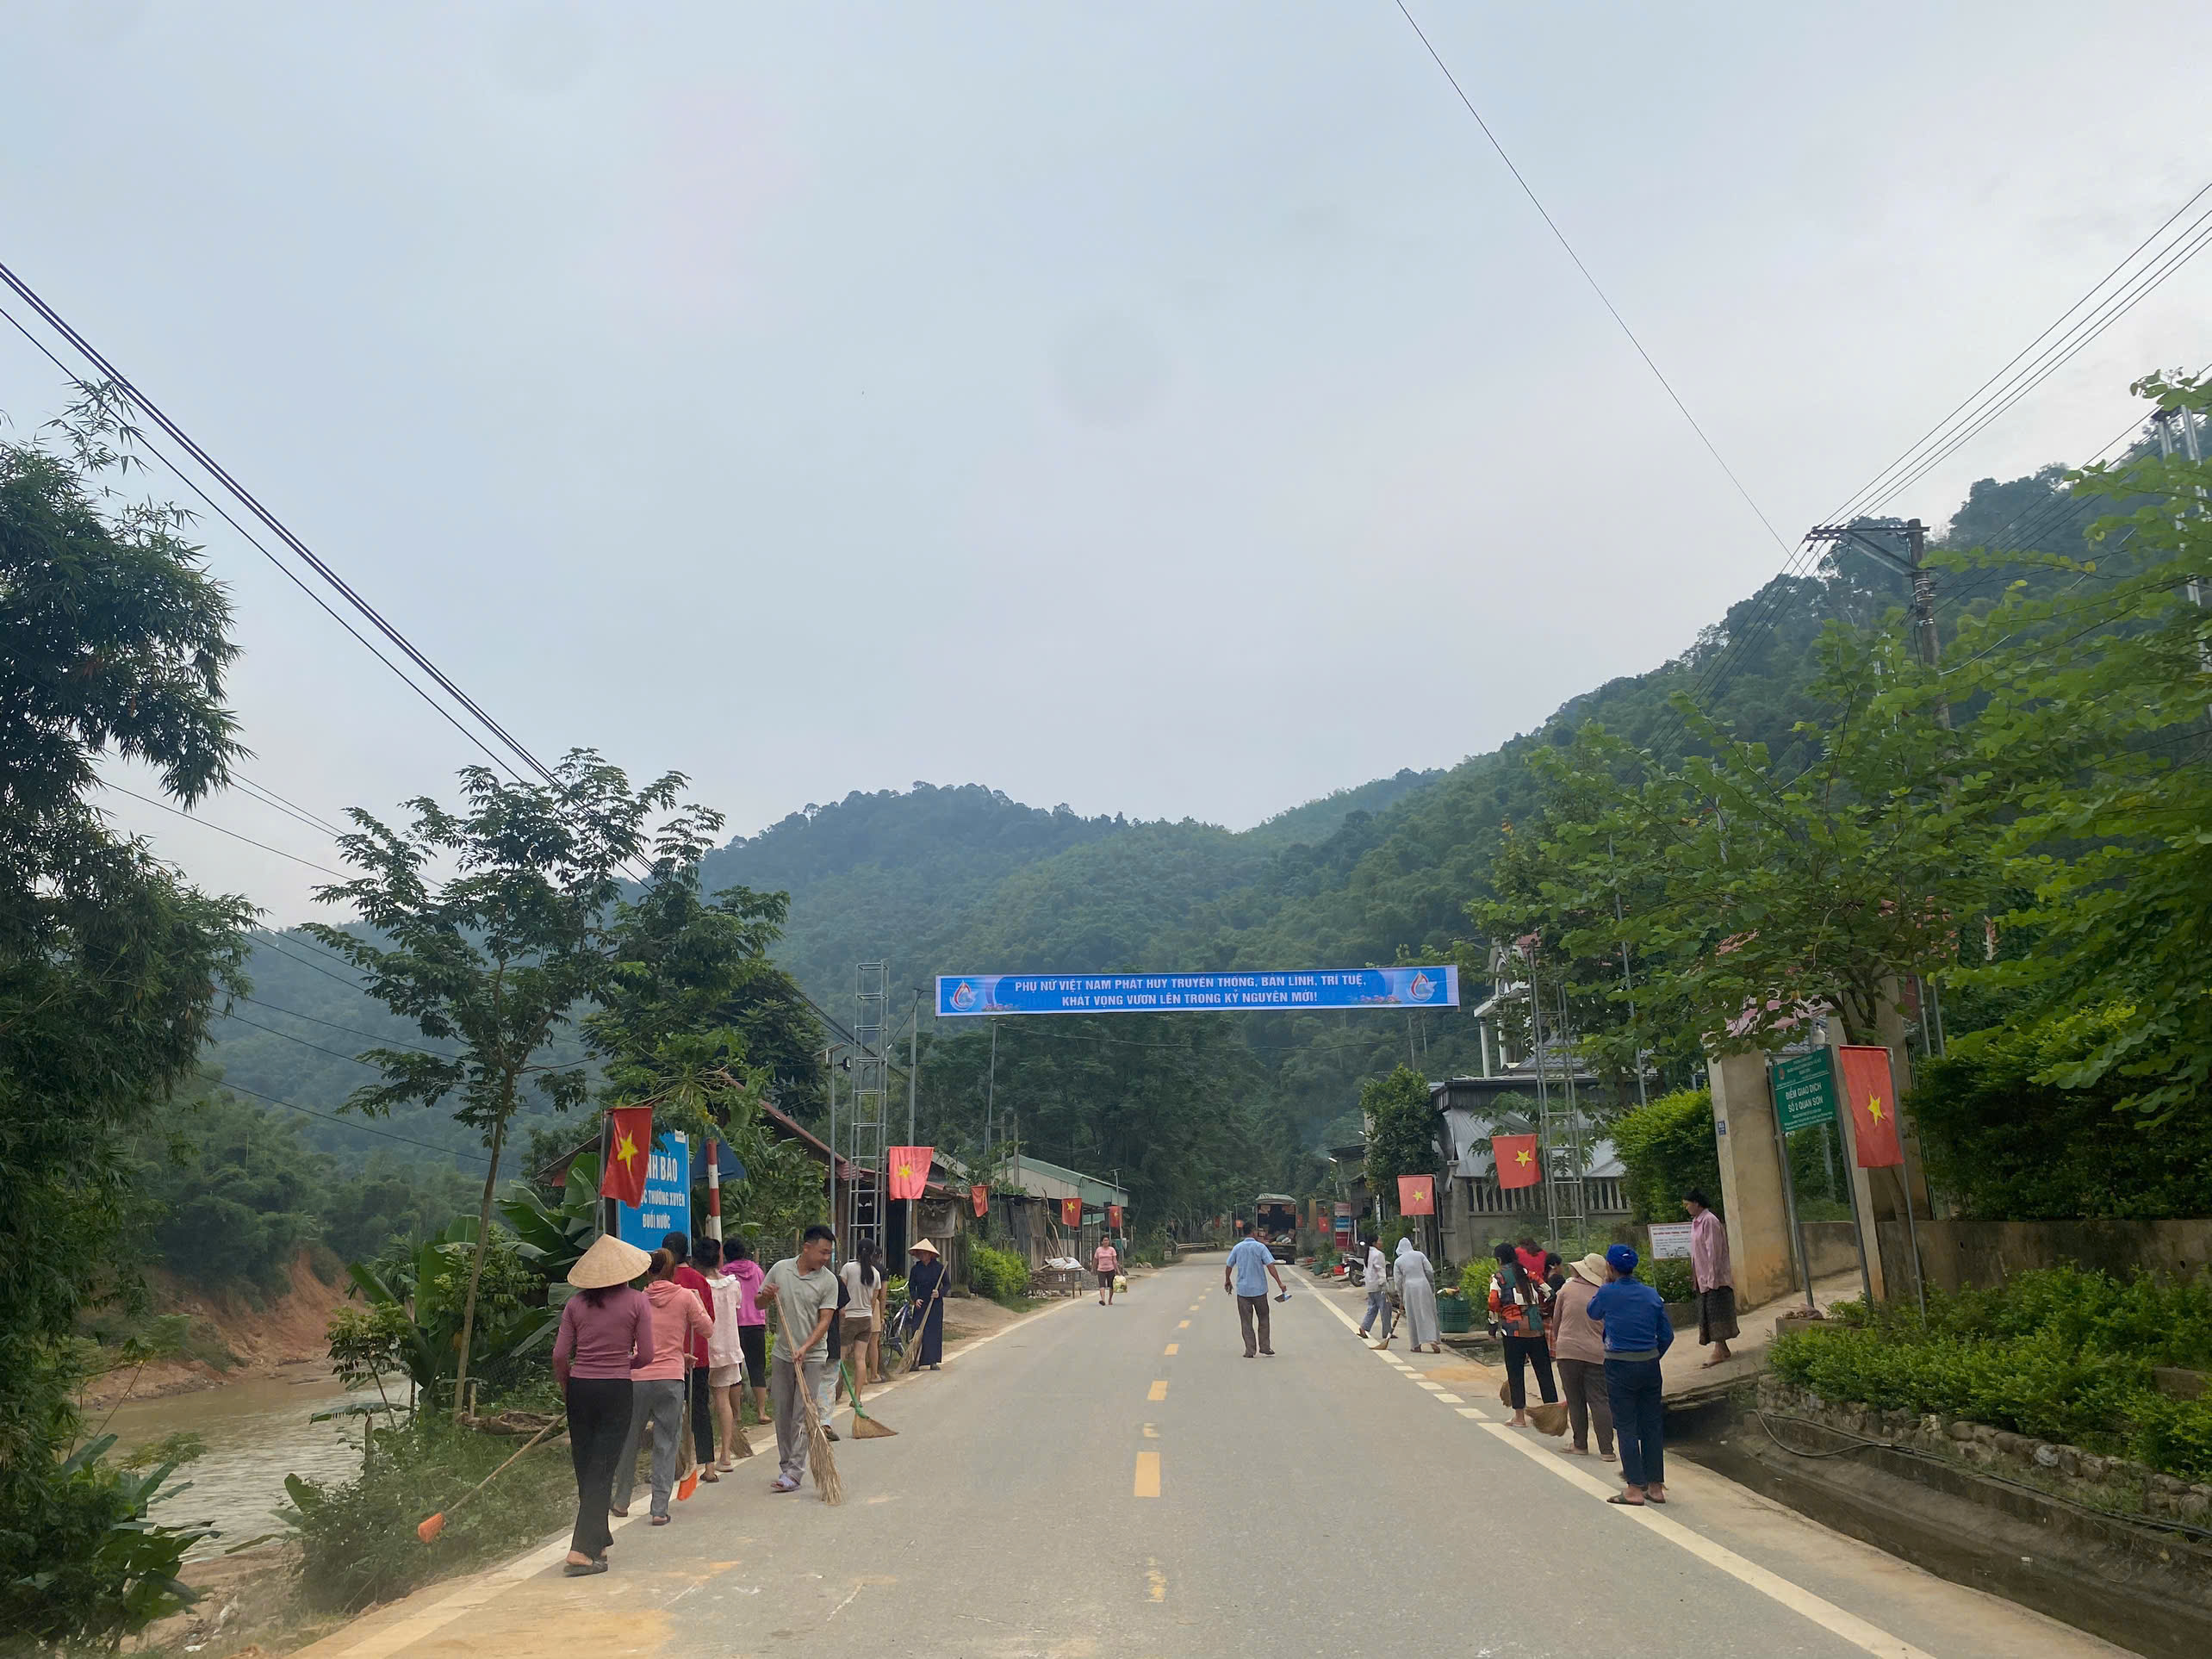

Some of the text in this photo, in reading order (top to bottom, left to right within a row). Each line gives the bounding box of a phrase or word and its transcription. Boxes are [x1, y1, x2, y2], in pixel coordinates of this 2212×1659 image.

[1015, 972, 1366, 993] PHỤ NỮ VIỆT NAM PHÁT HUY TRUYỀN THỐNG, BẢN LĨNH, TRÍ TUỆ,
[1062, 989, 1317, 1008] KHÁT VỌNG VƯƠN LÊN TRONG KỶ NGUYÊN MỚI!
[647, 1152, 677, 1183] NH BÁO
